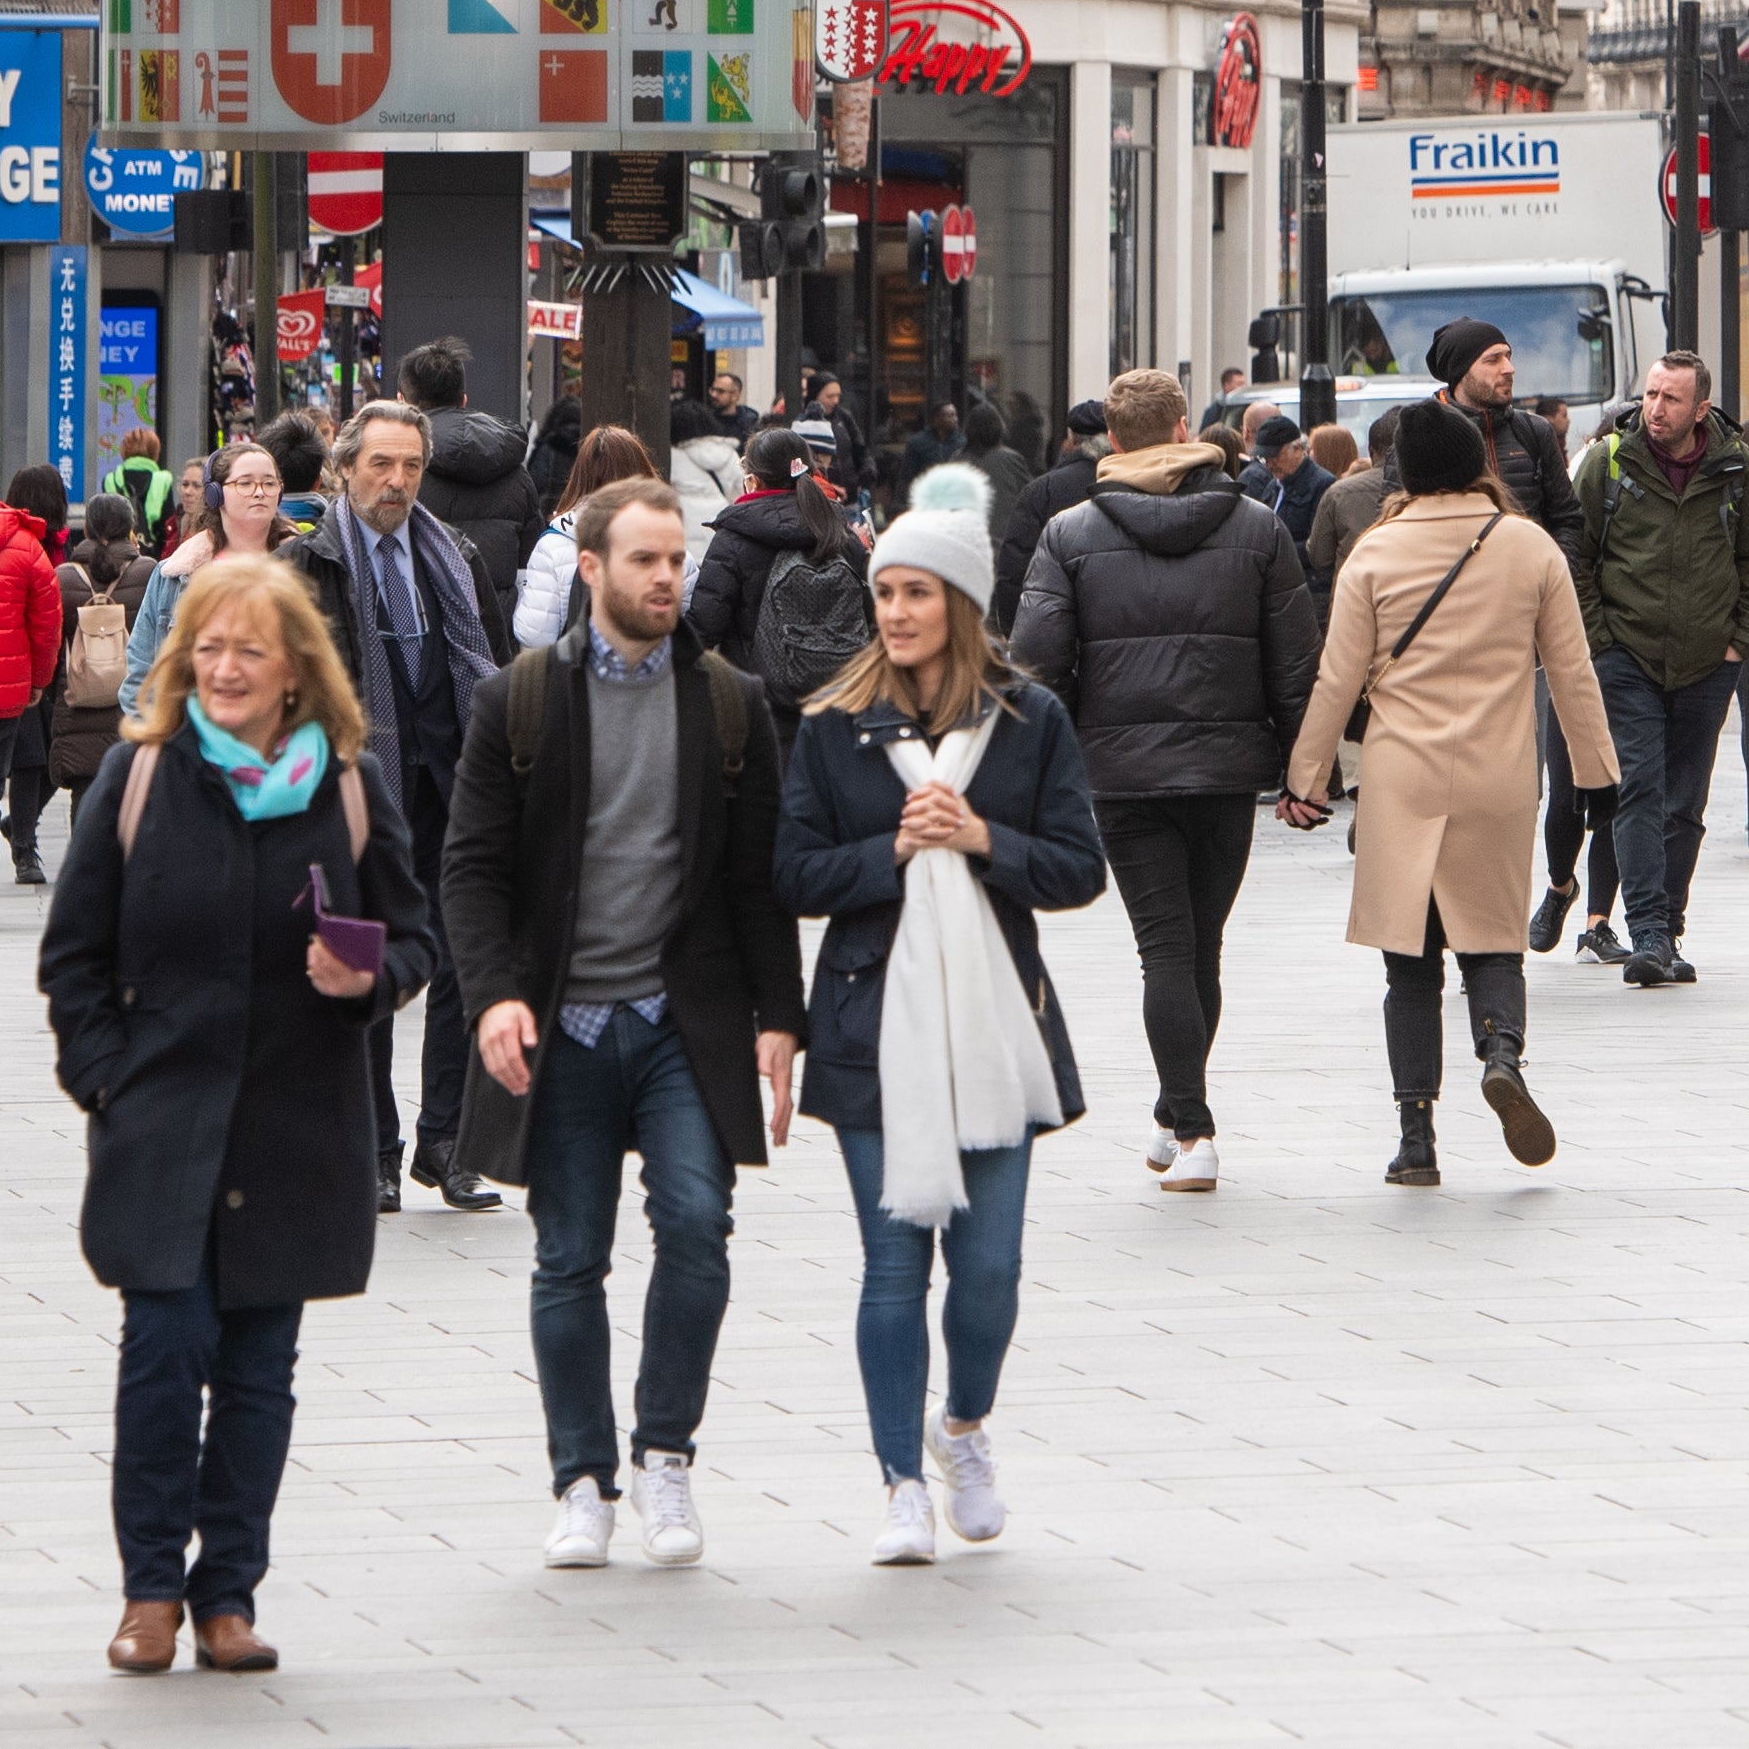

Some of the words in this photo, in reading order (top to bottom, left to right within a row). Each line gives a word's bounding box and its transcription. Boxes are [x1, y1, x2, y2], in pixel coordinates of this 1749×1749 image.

[877, 20, 1012, 96] Happy
[378, 110, 455, 125] Switzerland
[1409, 132, 1559, 171] Fraikin
[124, 160, 163, 177] ATM
[1411, 206, 1437, 219] YOU
[1446, 205, 1492, 218] DRIVE,
[1501, 203, 1517, 216] WE
[1527, 202, 1558, 215] CARE
[530, 309, 577, 331] ALE
[277, 338, 311, 352] ALL'S
